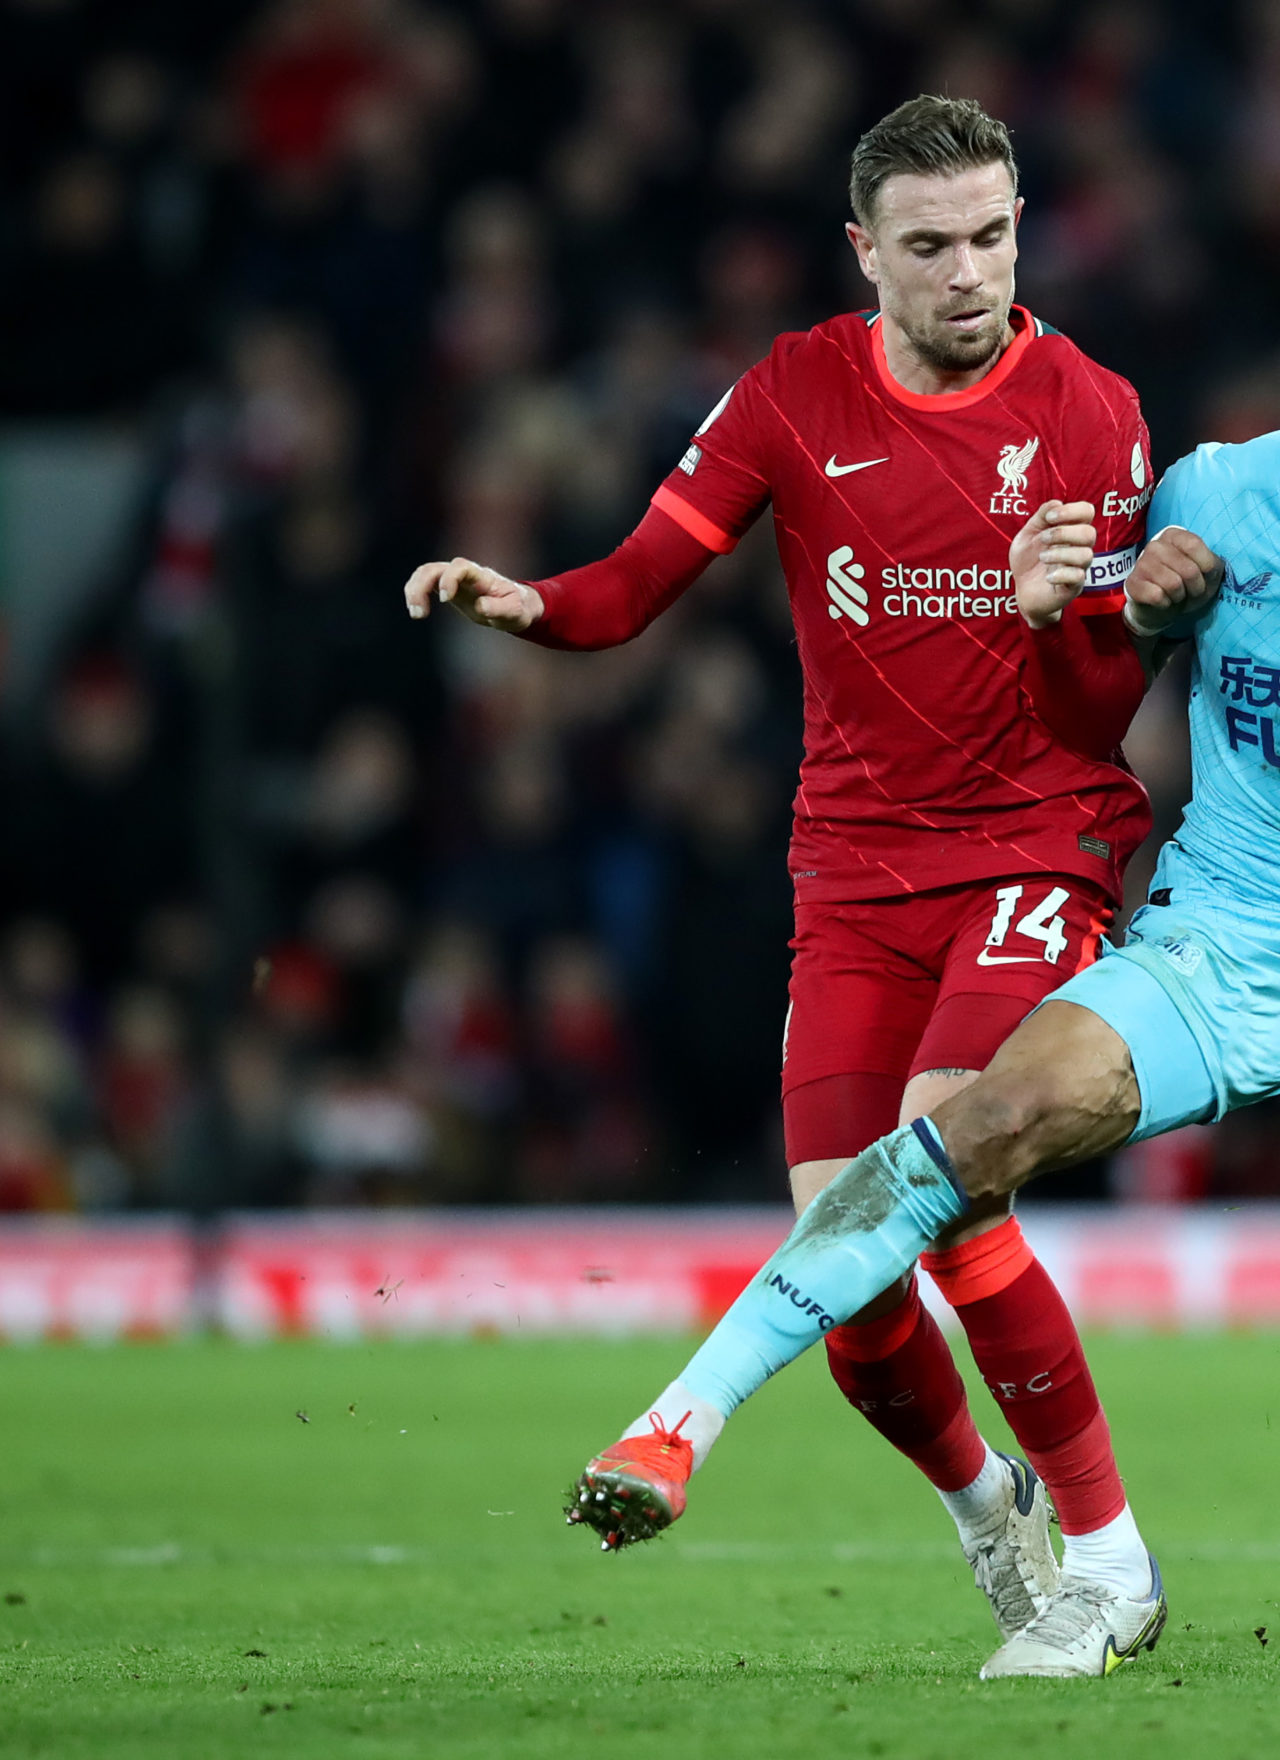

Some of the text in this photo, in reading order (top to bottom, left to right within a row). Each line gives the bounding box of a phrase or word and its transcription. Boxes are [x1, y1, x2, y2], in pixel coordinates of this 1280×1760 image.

[1085, 553, 1132, 584] ptain
[984, 884, 1071, 965] 14
[770, 1273, 835, 1331] NUFC
